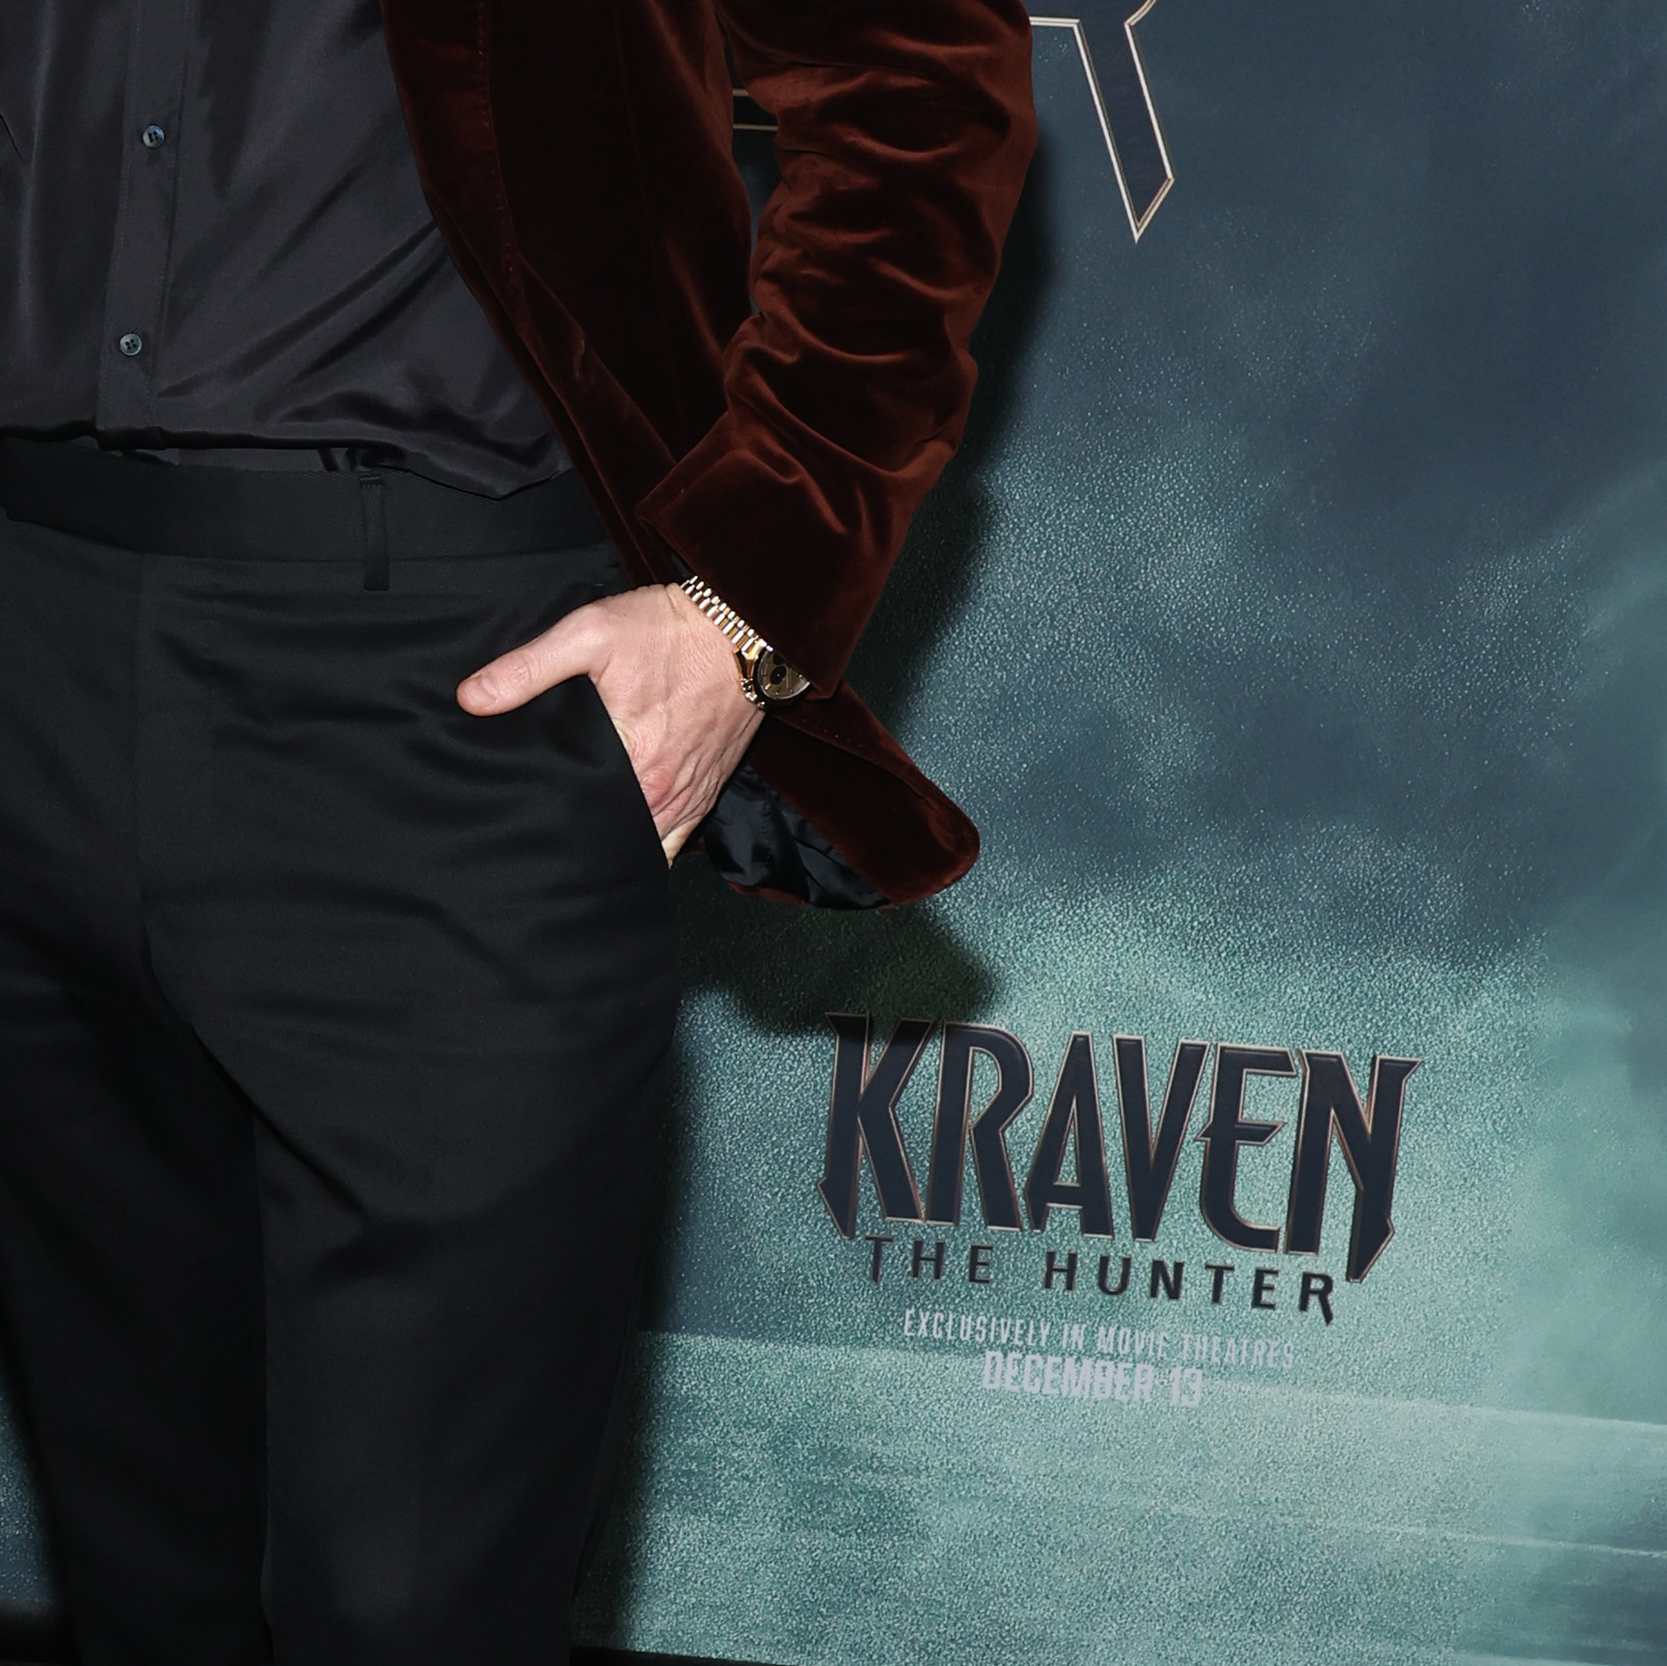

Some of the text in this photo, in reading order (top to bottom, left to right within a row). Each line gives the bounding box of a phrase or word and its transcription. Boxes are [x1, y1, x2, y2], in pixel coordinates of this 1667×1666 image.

[817, 1012, 1422, 1284] KRAVEN
[865, 1235, 1334, 1326] THE HUNTER
[903, 1307, 1295, 1370] EXCLUSIVELY IN MOVIE THEATRES
[983, 1349, 1203, 1410] DECEMBER 13
